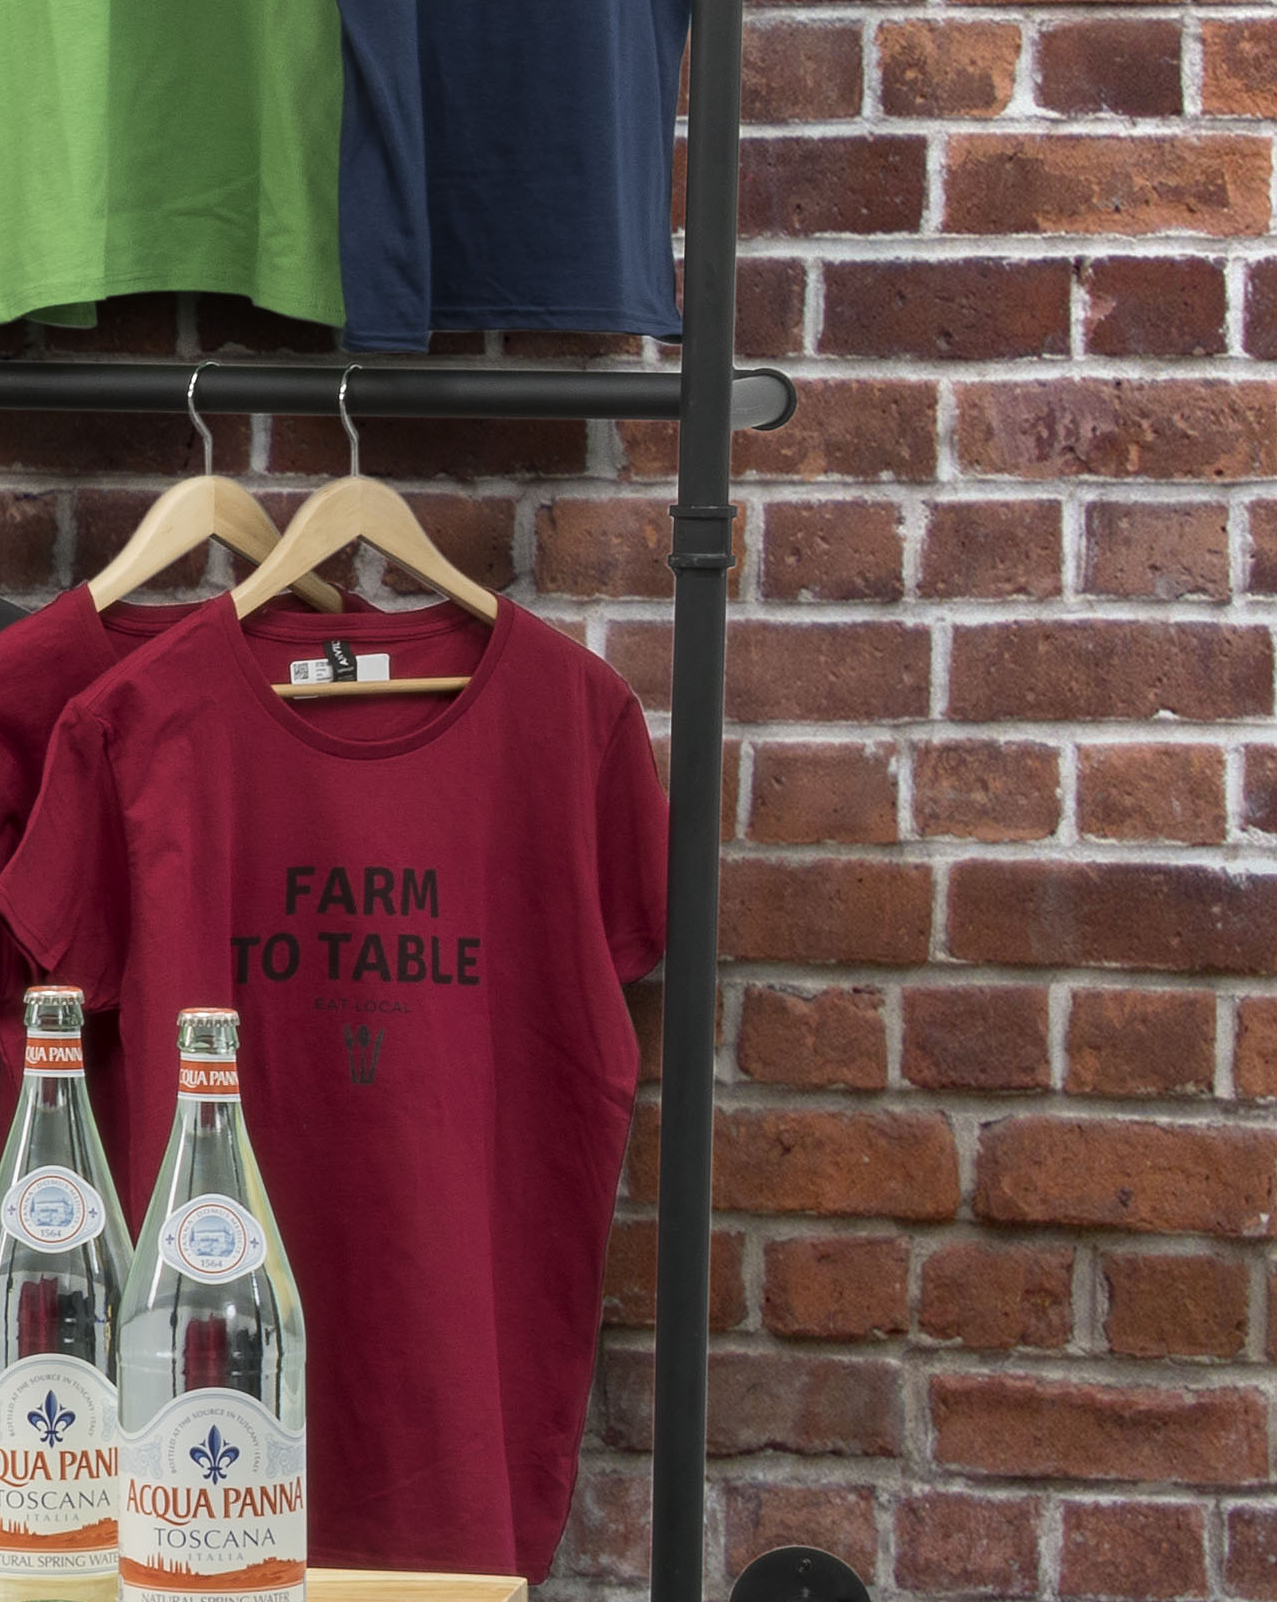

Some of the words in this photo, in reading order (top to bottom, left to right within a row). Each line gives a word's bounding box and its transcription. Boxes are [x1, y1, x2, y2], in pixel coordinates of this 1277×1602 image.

[284, 865, 440, 919] FARM
[231, 932, 300, 986] TO
[317, 932, 481, 986] TABLE
[314, 997, 351, 1010] EAT
[353, 998, 414, 1015] LOCAL
[127, 1478, 215, 1526] ACQUA
[223, 1476, 304, 1519] PANNA
[26, 1513, 80, 1522] ITALIA
[153, 1528, 276, 1549] TOSCANA
[37, 1553, 86, 1568] SPRING
[188, 1552, 244, 1561] ITALIA
